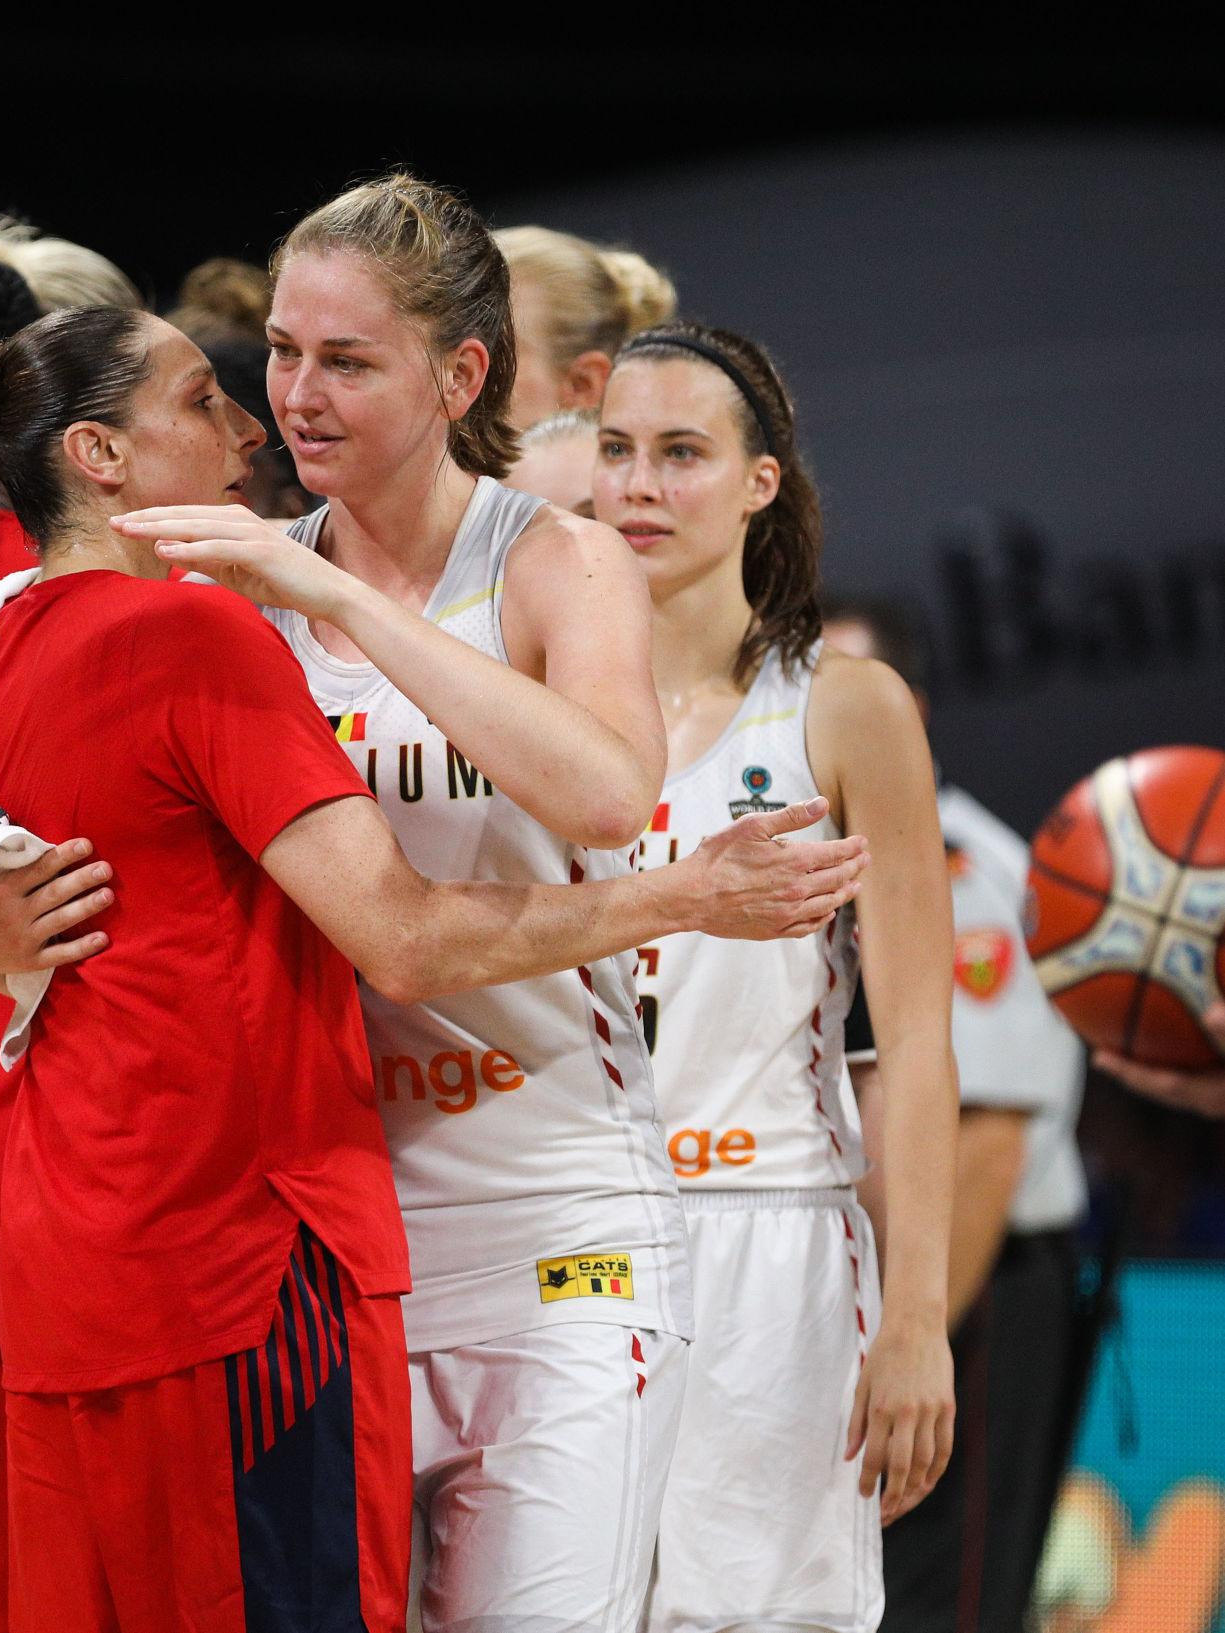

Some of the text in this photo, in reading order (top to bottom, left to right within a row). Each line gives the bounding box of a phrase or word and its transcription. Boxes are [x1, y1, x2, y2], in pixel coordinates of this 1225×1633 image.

[381, 1050, 525, 1114] nge
[668, 1129, 756, 1178] ge
[578, 1261, 628, 1272] CATS
